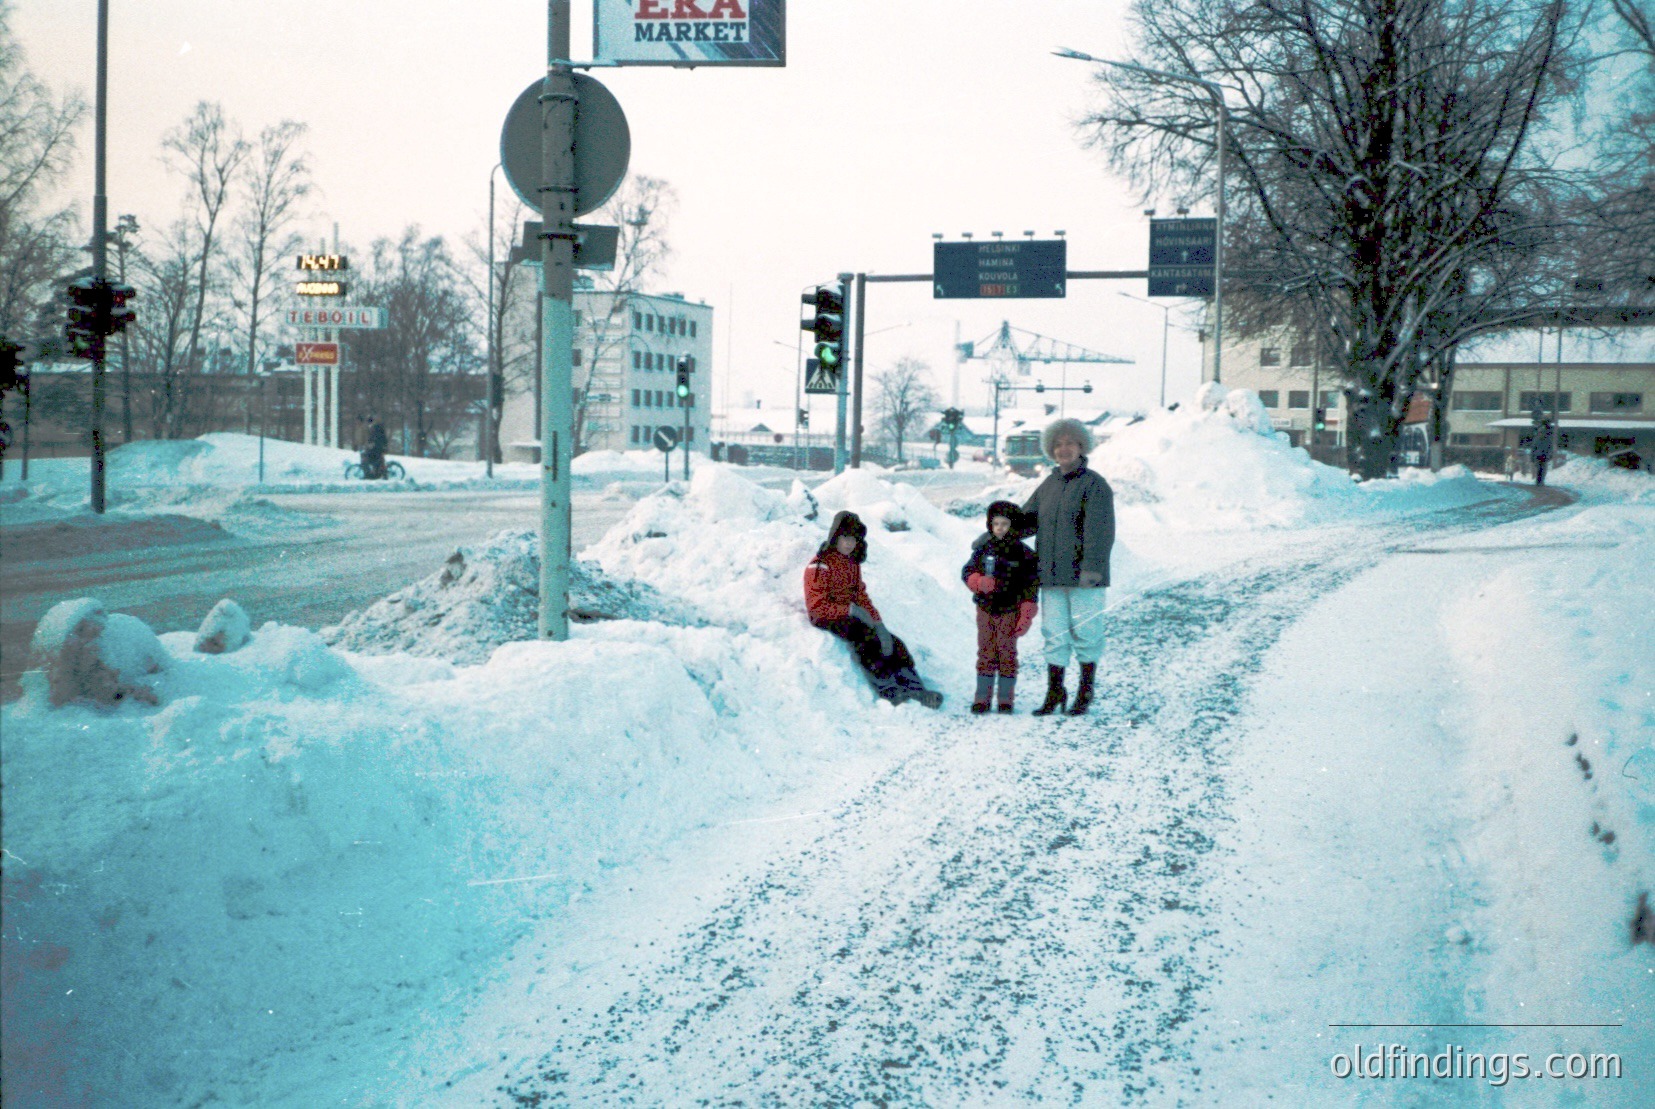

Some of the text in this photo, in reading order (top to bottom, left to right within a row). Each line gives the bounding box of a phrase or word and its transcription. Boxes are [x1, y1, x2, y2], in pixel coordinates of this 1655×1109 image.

[634, 22, 746, 42] MARKET
[978, 244, 1020, 253] HELSINKI
[978, 258, 1014, 267] HAMINA
[978, 272, 1018, 281] KOUVOLA
[290, 311, 368, 324] TEBOIL
